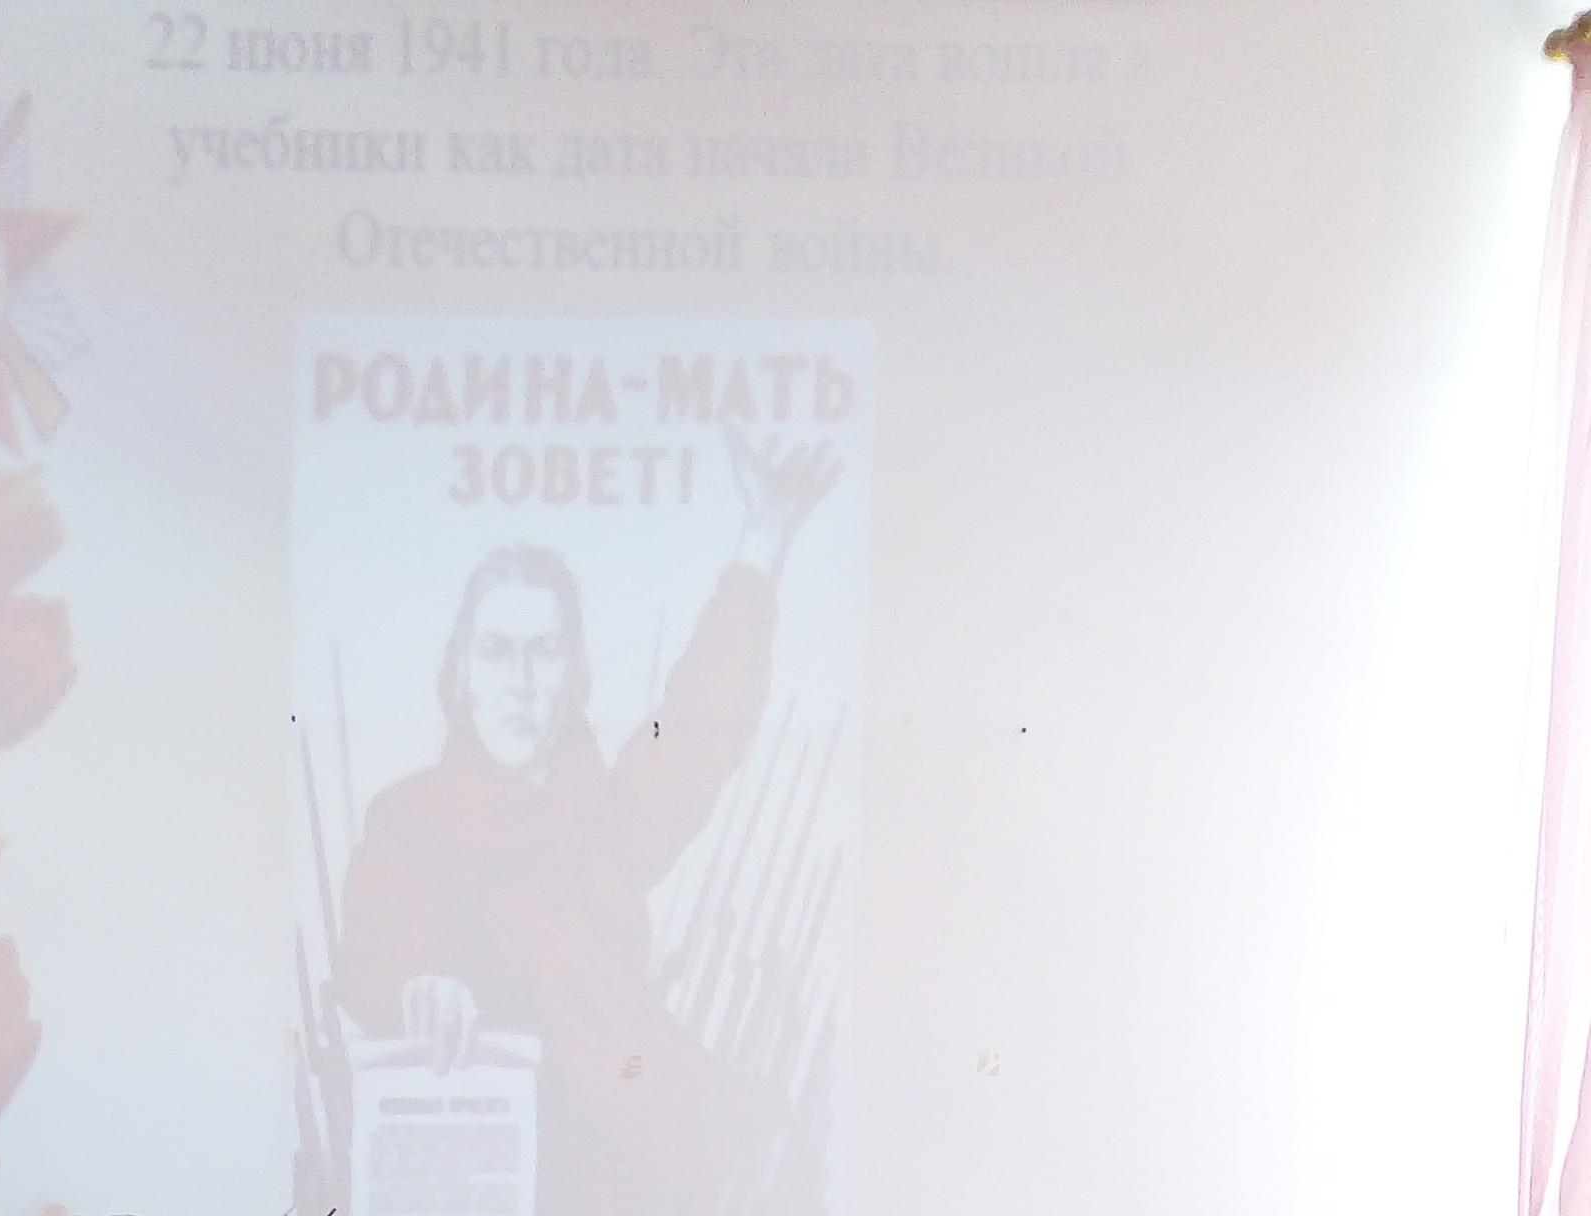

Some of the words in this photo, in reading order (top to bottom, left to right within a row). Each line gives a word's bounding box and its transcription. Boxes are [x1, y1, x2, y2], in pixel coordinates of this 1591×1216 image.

[145, 11, 207, 71] 22
[226, 27, 374, 74] июня
[396, 17, 512, 77] 1941
[165, 112, 428, 185] учебники
[446, 129, 538, 175] как
[552, 130, 669, 180] дата
[335, 207, 746, 272] Отечественной
[311, 350, 858, 426] РОДИНА-МАТЬ
